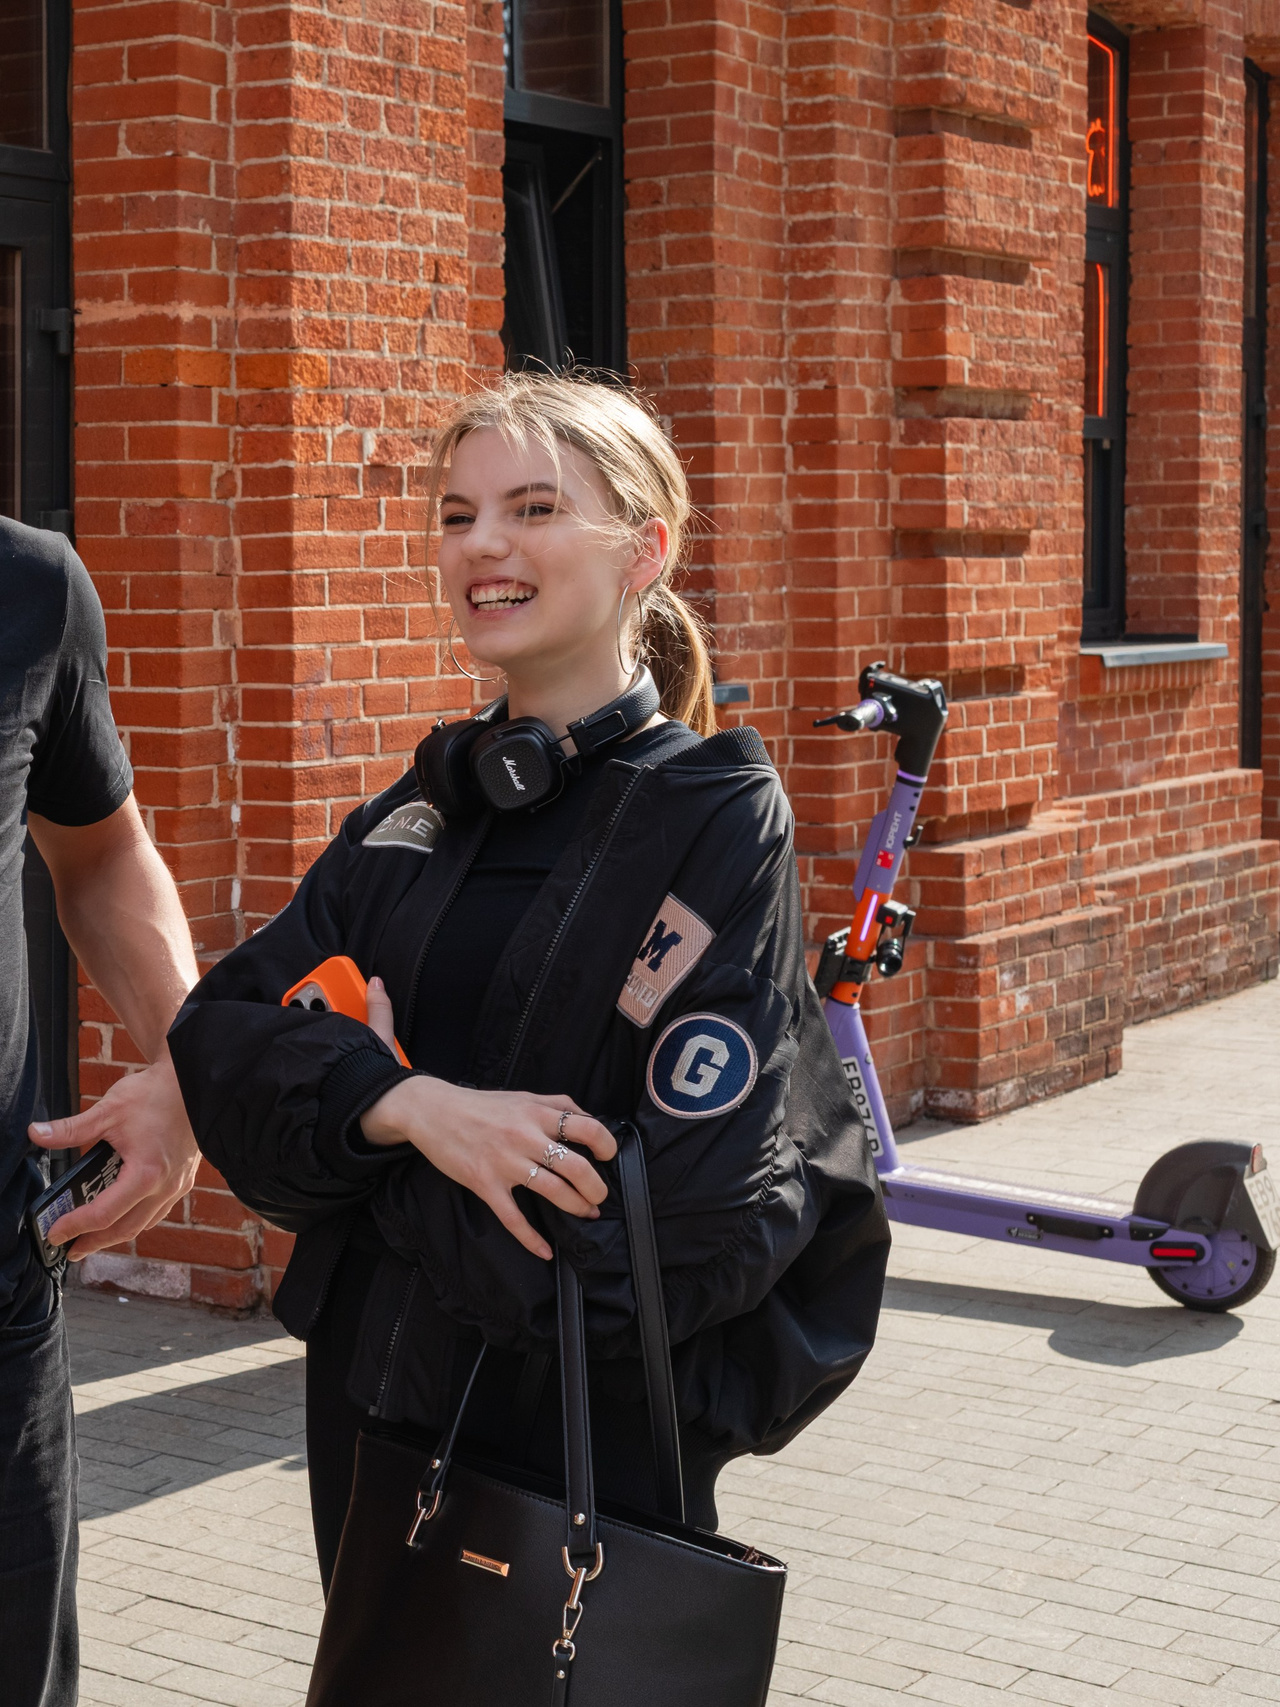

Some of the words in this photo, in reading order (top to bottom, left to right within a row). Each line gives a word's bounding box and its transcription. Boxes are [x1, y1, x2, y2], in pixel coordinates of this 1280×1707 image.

[502, 755, 526, 792] Marshall
[885, 811, 902, 849] ЮРЕНТ
[637, 919, 683, 973] M
[670, 1033, 730, 1098] G
